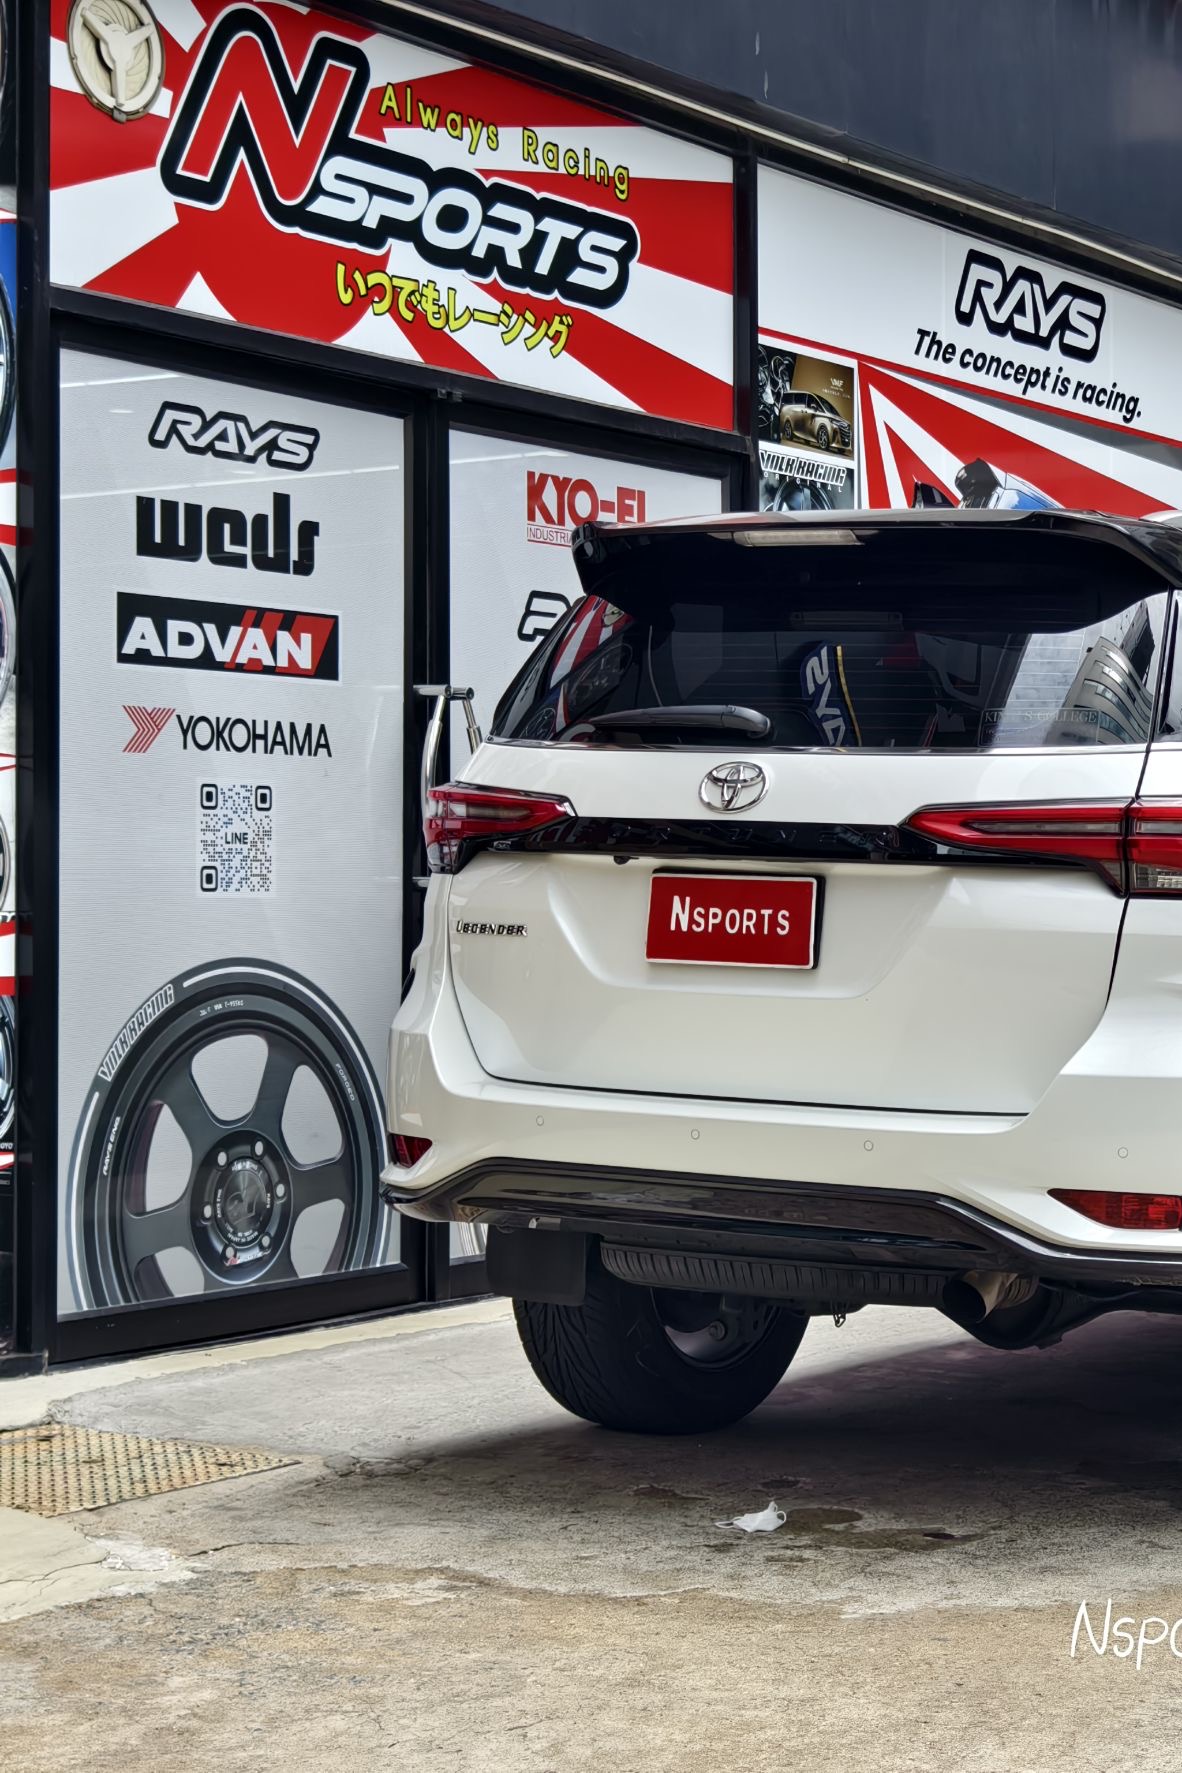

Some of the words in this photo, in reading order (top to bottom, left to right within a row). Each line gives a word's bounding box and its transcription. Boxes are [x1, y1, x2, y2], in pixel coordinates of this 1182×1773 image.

[379, 82, 499, 154] Always
[522, 127, 631, 200] Racing
[336, 262, 573, 358] いつでもレーシング
[955, 249, 1107, 364] RAYS
[914, 328, 957, 364] The
[959, 347, 1053, 396] concept
[1051, 366, 1072, 397] is
[1072, 382, 1143, 424] racing.
[148, 400, 320, 472] RAYS
[759, 450, 795, 478] VOLK
[794, 457, 847, 488] RACING
[763, 472, 843, 493] ORIGINAL
[527, 471, 646, 526] KYO-EI
[121, 615, 313, 670] ADVAN
[176, 713, 333, 758] YOKOHAMA
[225, 832, 249, 845] LINE
[456, 919, 528, 937] LEGENDER
[670, 895, 790, 936] NSPORTS
[98, 1028, 131, 1082] VOLK
[126, 984, 175, 1046] RACING
[0, 1142, 13, 1150] OYO
